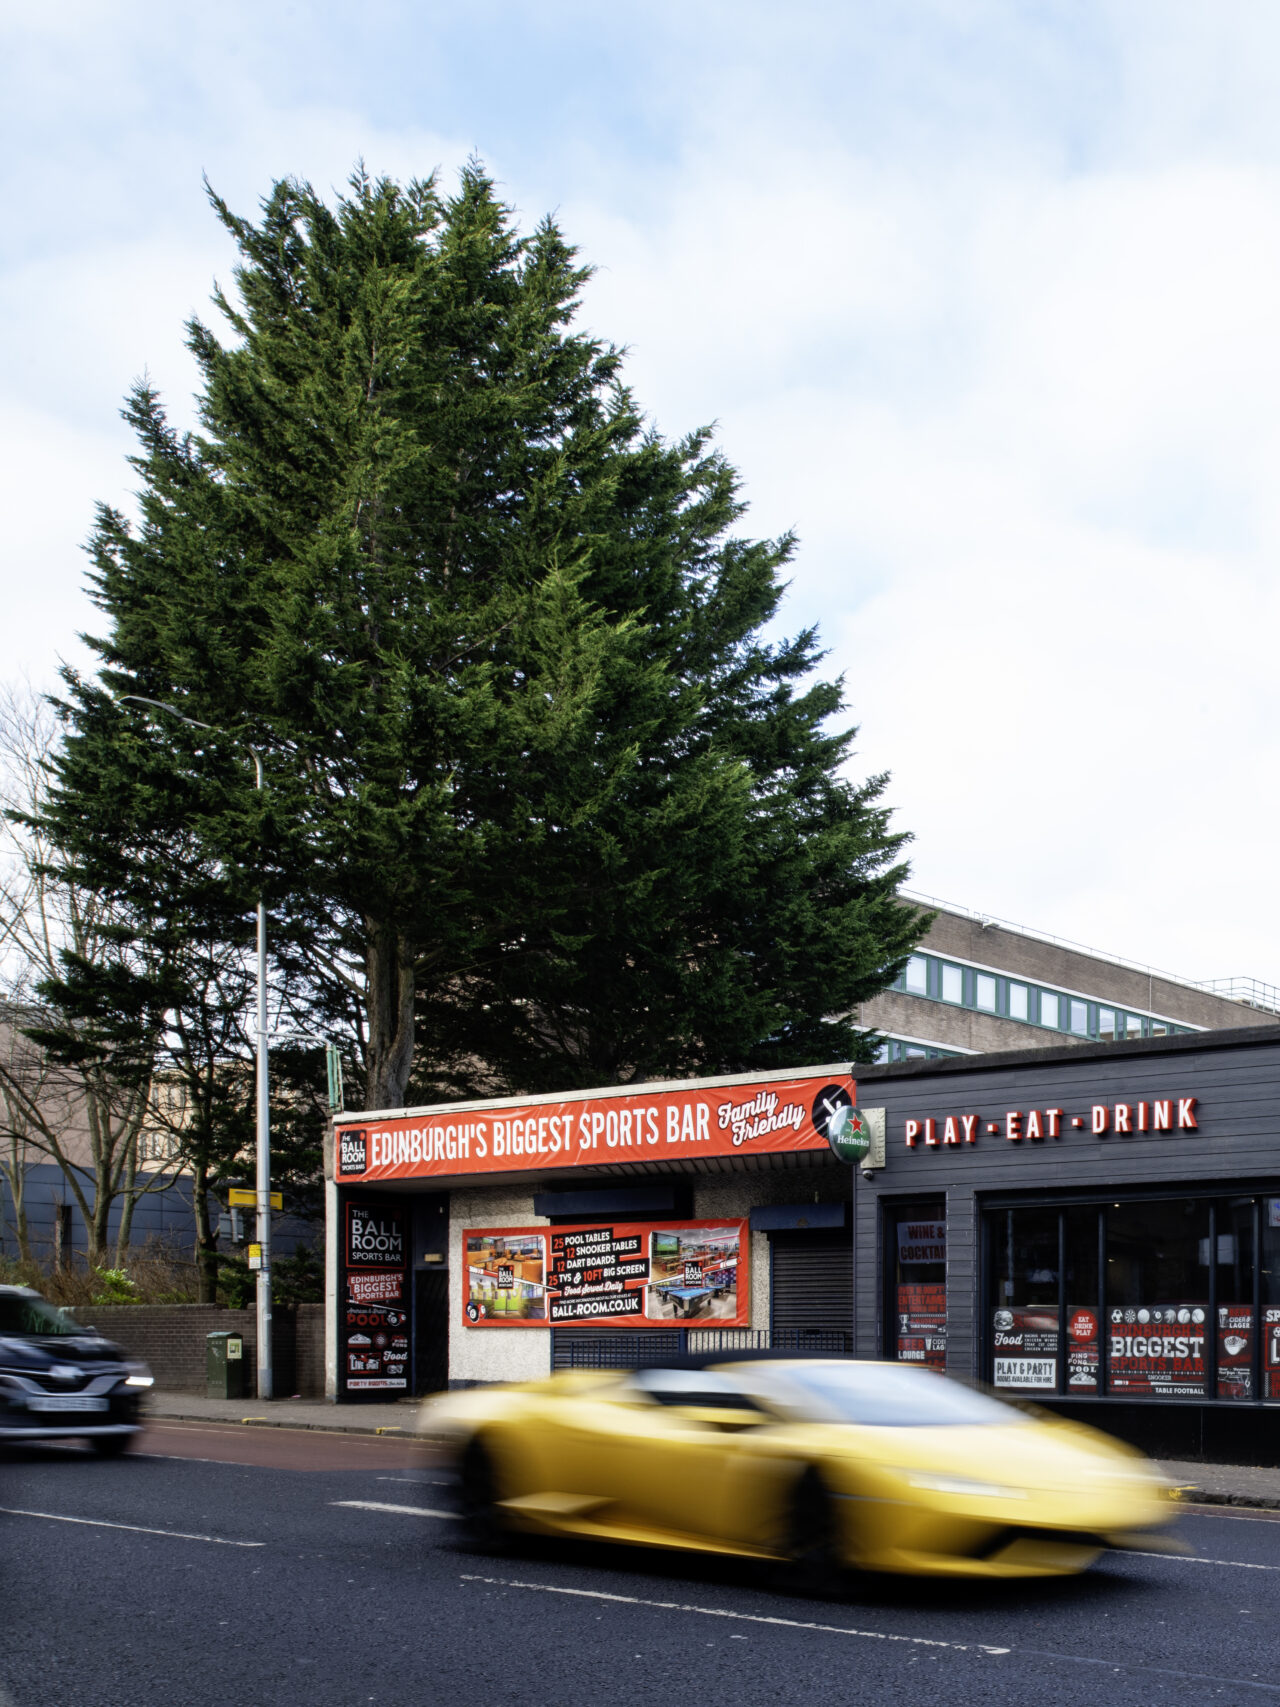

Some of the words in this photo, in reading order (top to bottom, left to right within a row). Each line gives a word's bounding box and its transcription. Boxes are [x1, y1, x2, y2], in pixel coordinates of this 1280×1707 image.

[717, 1090, 779, 1130] Family
[731, 1103, 806, 1147] Friendly
[905, 1114, 980, 1147] PLAY
[1006, 1108, 1063, 1139] EAT
[1091, 1098, 1199, 1134] DRINK
[371, 1122, 487, 1166] EDINBURGH'S
[493, 1115, 574, 1156] BIGGEST
[579, 1107, 659, 1150] SPORTS
[666, 1103, 710, 1143] BAR
[837, 1135, 870, 1147] Heineken
[341, 1141, 365, 1153] BALL
[341, 1151, 365, 1163] ROOM
[352, 1209, 369, 1218] THE
[352, 1219, 401, 1236] BALL
[908, 1225, 935, 1240] WINE
[936, 1226, 945, 1239] &
[352, 1234, 402, 1251] ROOM
[553, 1238, 564, 1249] 25
[564, 1236, 584, 1246] POOL
[585, 1232, 610, 1242] TABLES
[566, 1248, 575, 1258] 12
[575, 1243, 611, 1256] SNOOKER
[612, 1240, 637, 1251] TABLES
[352, 1252, 383, 1261] SPORTS
[385, 1253, 401, 1262] BAR
[557, 1261, 565, 1271] 12
[566, 1258, 586, 1269] DART
[586, 1255, 615, 1267] BOARDS
[350, 1273, 404, 1284] EDINBURGH'S
[548, 1275, 558, 1286] 25
[573, 1272, 581, 1284] &
[583, 1269, 602, 1281] 10FT
[603, 1268, 616, 1277] BIG
[616, 1264, 645, 1275] SCREEN
[353, 1281, 398, 1293] BIGGEST
[564, 1286, 581, 1296] Food
[605, 1281, 624, 1293] Daily
[356, 1291, 384, 1300] SPORTS
[385, 1290, 399, 1298] BAR
[552, 1298, 639, 1318] BALL-ROOM.CO.UK
[346, 1313, 388, 1326] POOL
[1111, 1324, 1205, 1337] EDINBURGH'S
[898, 1339, 924, 1350] BEER
[994, 1332, 1023, 1346] Food
[898, 1350, 925, 1359] LOUNGE
[1110, 1337, 1204, 1358] BIGGEST
[383, 1350, 408, 1361] Food
[997, 1362, 1018, 1375] PLAY
[1027, 1362, 1053, 1376] PARTY
[1111, 1357, 1166, 1370] SPORTS
[1173, 1358, 1205, 1371] BAR
[997, 1375, 1011, 1383] ROOMS
